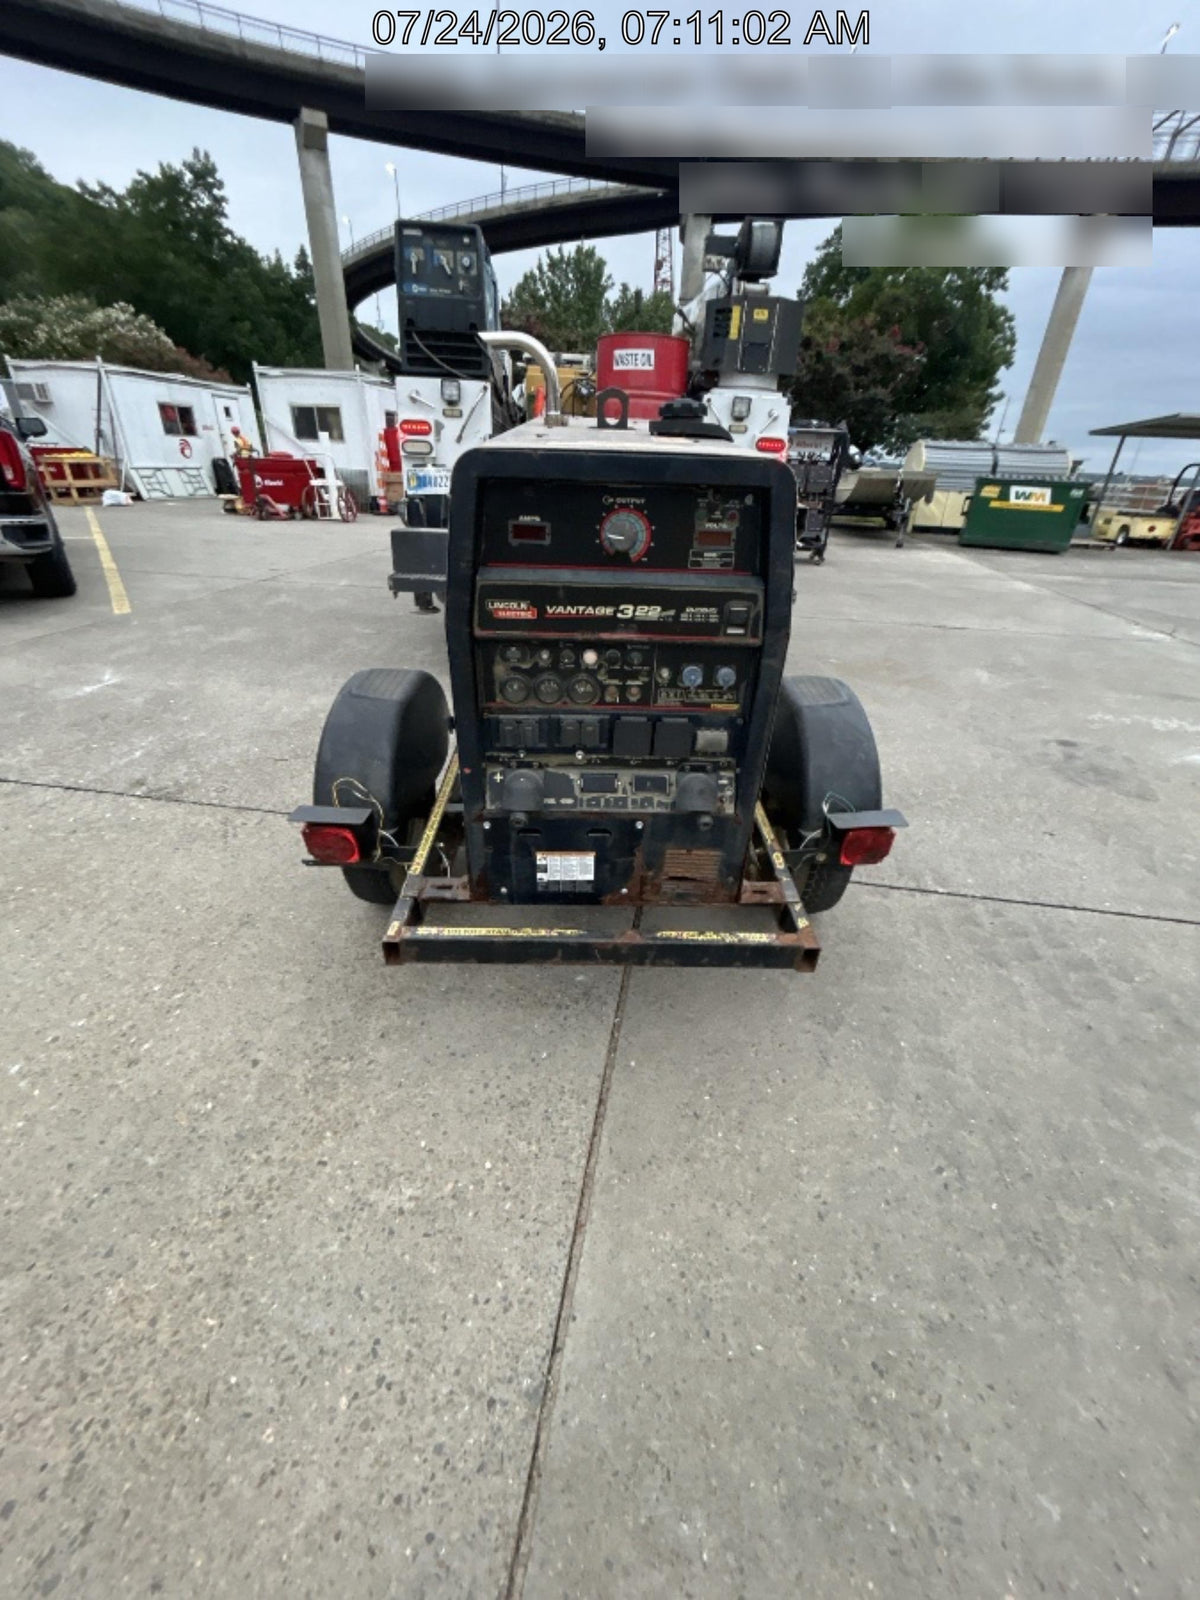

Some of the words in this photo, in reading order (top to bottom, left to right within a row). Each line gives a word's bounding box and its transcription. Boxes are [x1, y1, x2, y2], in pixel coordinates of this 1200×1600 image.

[614, 352, 639, 367] WASTE
[1014, 490, 1048, 502] WM
[488, 601, 529, 610] LINCOLN
[546, 605, 617, 616] VANTAGE
[616, 604, 662, 619] 322
